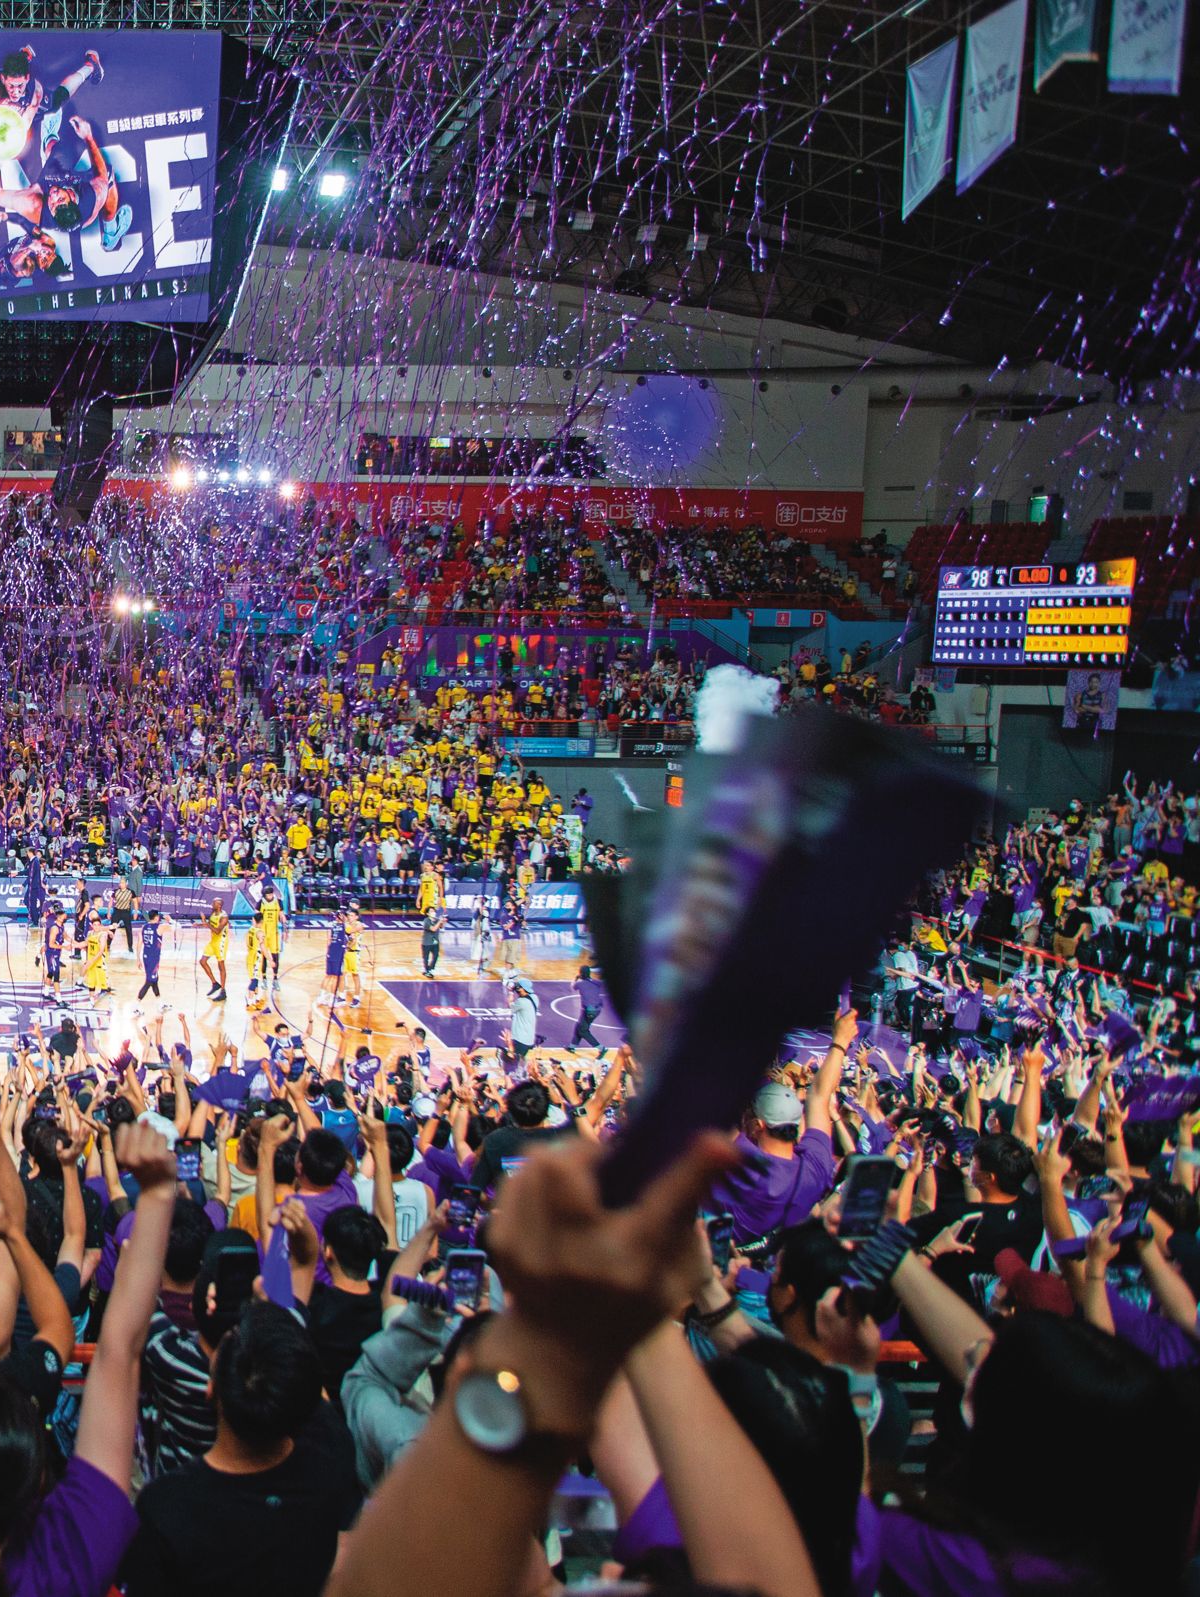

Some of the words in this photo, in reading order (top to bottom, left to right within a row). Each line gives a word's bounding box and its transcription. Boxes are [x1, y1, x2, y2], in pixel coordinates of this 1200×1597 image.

[36, 292, 74, 311] THE
[777, 504, 848, 525] 街口支付
[971, 569, 989, 588] 98
[1076, 564, 1096, 585] 93
[813, 613, 824, 625] D
